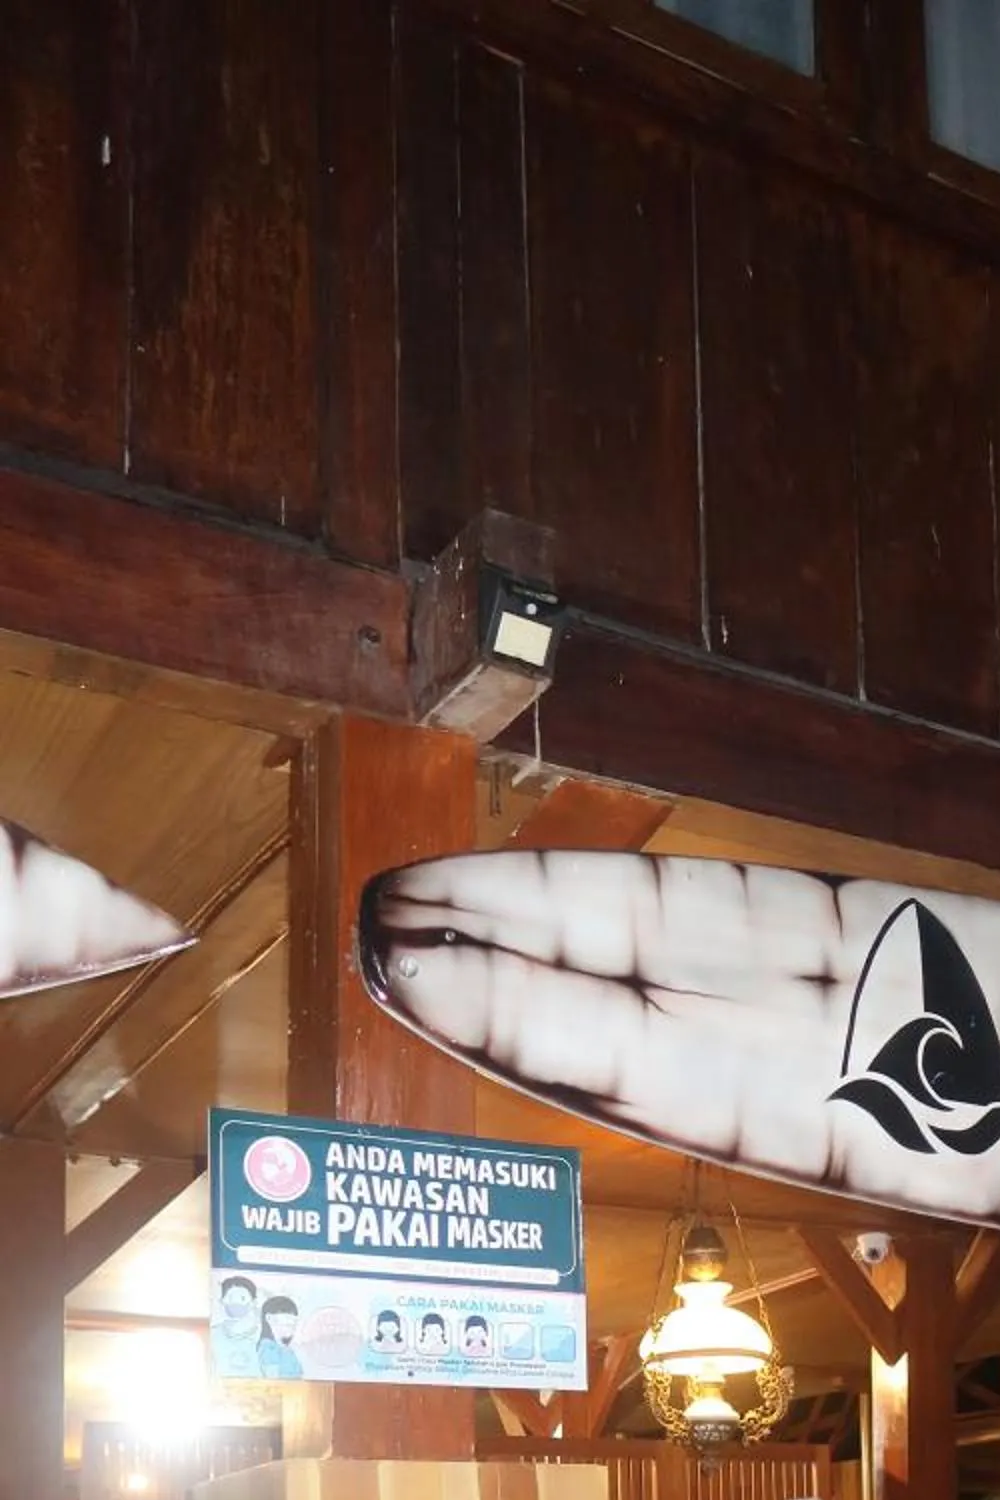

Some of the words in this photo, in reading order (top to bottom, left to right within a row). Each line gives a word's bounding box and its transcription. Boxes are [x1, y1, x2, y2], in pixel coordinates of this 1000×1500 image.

[325, 1142, 405, 1176] ANDA
[413, 1152, 557, 1191] MEMASUKI
[325, 1171, 489, 1216] KAWASAN
[242, 1205, 321, 1234] WAJIB
[327, 1205, 439, 1249] PAKAI
[447, 1216, 543, 1251] MASKER
